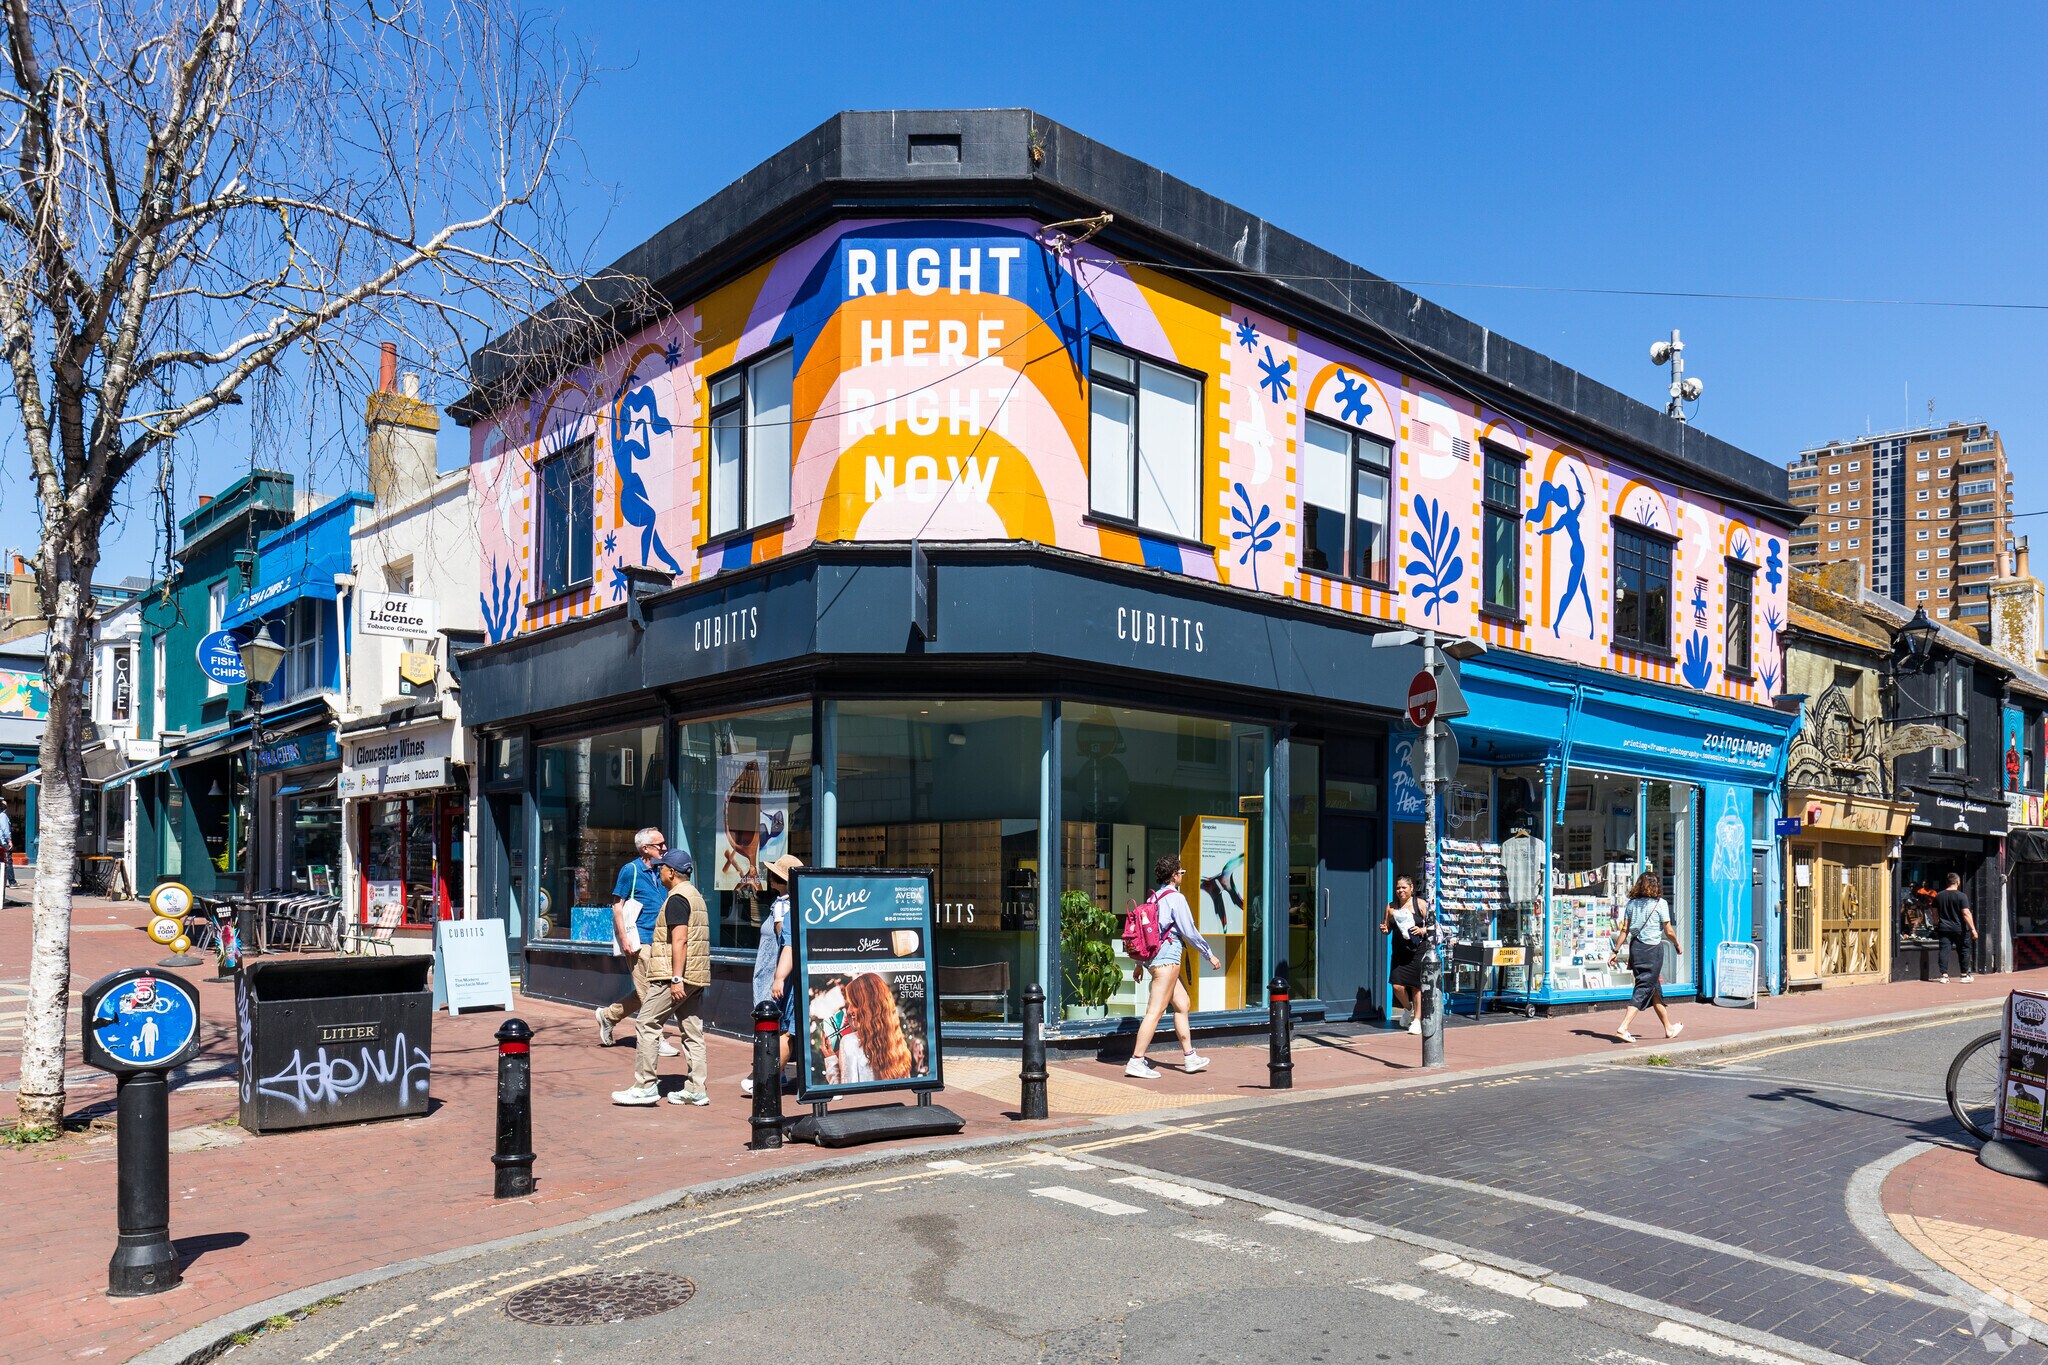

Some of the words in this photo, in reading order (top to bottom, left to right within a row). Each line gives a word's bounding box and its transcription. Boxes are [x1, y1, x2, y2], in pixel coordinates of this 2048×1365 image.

[848, 247, 1020, 296] RIGHT
[861, 320, 1005, 367] HERE
[847, 388, 1020, 435] RIGHT
[865, 456, 1000, 503] NOW
[385, 600, 408, 612] Off
[369, 610, 424, 625] Licence
[367, 622, 394, 631] Tobacco
[397, 625, 428, 634] Groceries
[694, 606, 758, 652] CUBITTS
[1117, 606, 1204, 653] CUBITTS
[210, 656, 236, 666] FISH
[212, 666, 246, 678] CHIPS
[116, 657, 129, 710] CAFE
[134, 746, 156, 754] Aesop
[356, 743, 399, 765] Gloucester
[399, 737, 425, 758] Wines
[1622, 738, 1648, 751] printing
[1669, 747, 1700, 759] photography
[1703, 730, 1772, 759] zoingimage
[384, 771, 410, 785] Groceries
[414, 769, 440, 781] Tobacco
[895, 891, 922, 900] AVEDA
[804, 885, 872, 924] Shine
[936, 903, 975, 924] ITTS
[448, 927, 485, 938] CUBITTS
[857, 937, 882, 953] Shine
[1722, 947, 1754, 958] printing
[809, 965, 829, 973] MODELS
[829, 964, 853, 972] REQUIRED
[857, 963, 878, 972] STUDENT
[878, 963, 900, 971] DISCOUNT
[900, 962, 925, 970] AVAILABLE
[1722, 957, 1753, 968] framing
[893, 974, 925, 984] AVEDA
[899, 983, 924, 991] RETAIL
[900, 990, 925, 999] STORE
[2015, 1002, 2047, 1017] CAPTAINS
[2019, 1010, 2042, 1020] BEARD
[322, 1025, 376, 1041] LITTER
